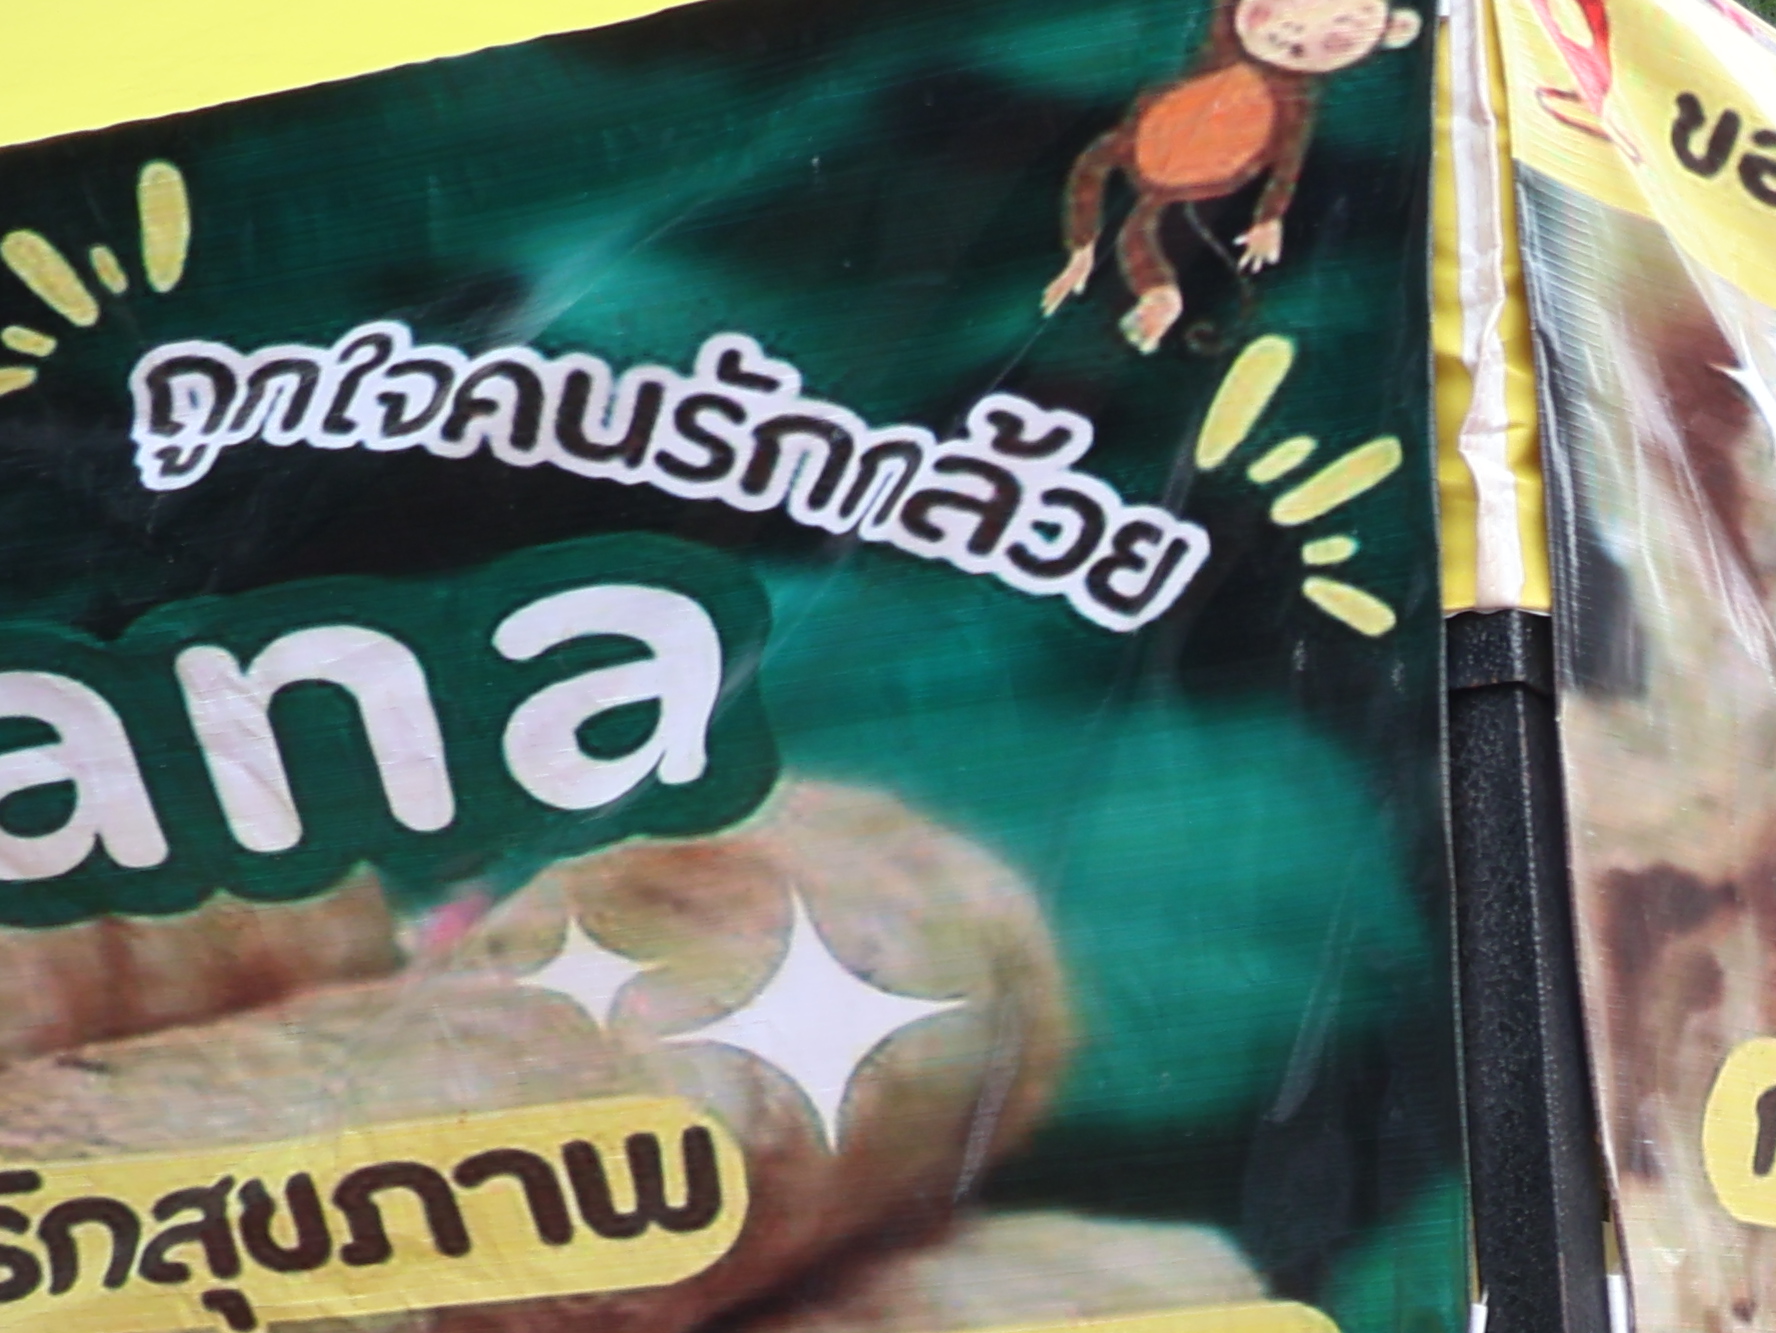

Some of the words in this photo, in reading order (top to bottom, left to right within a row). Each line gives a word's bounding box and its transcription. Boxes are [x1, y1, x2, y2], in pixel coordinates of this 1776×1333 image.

[143, 333, 1192, 618] ถูกใจคนรักกล้วย
